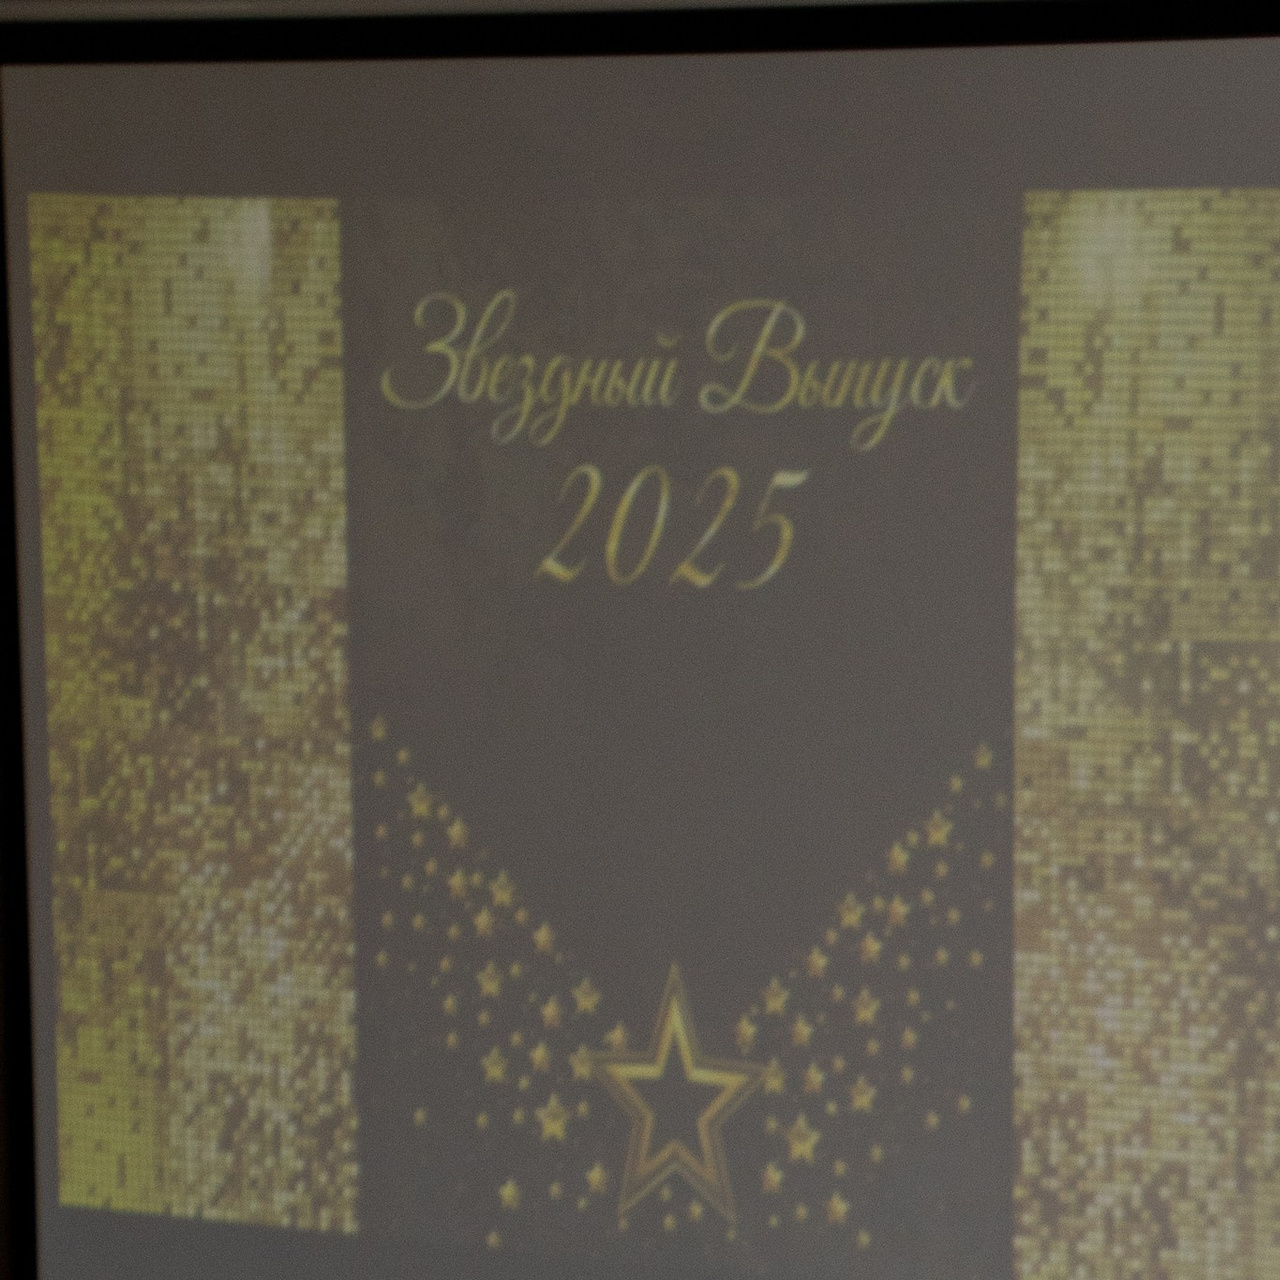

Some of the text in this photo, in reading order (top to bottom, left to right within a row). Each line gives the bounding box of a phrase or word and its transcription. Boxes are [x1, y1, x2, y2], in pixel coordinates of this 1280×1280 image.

[380, 288, 974, 452] Звездный Выпуск
[532, 464, 811, 590] 2025
